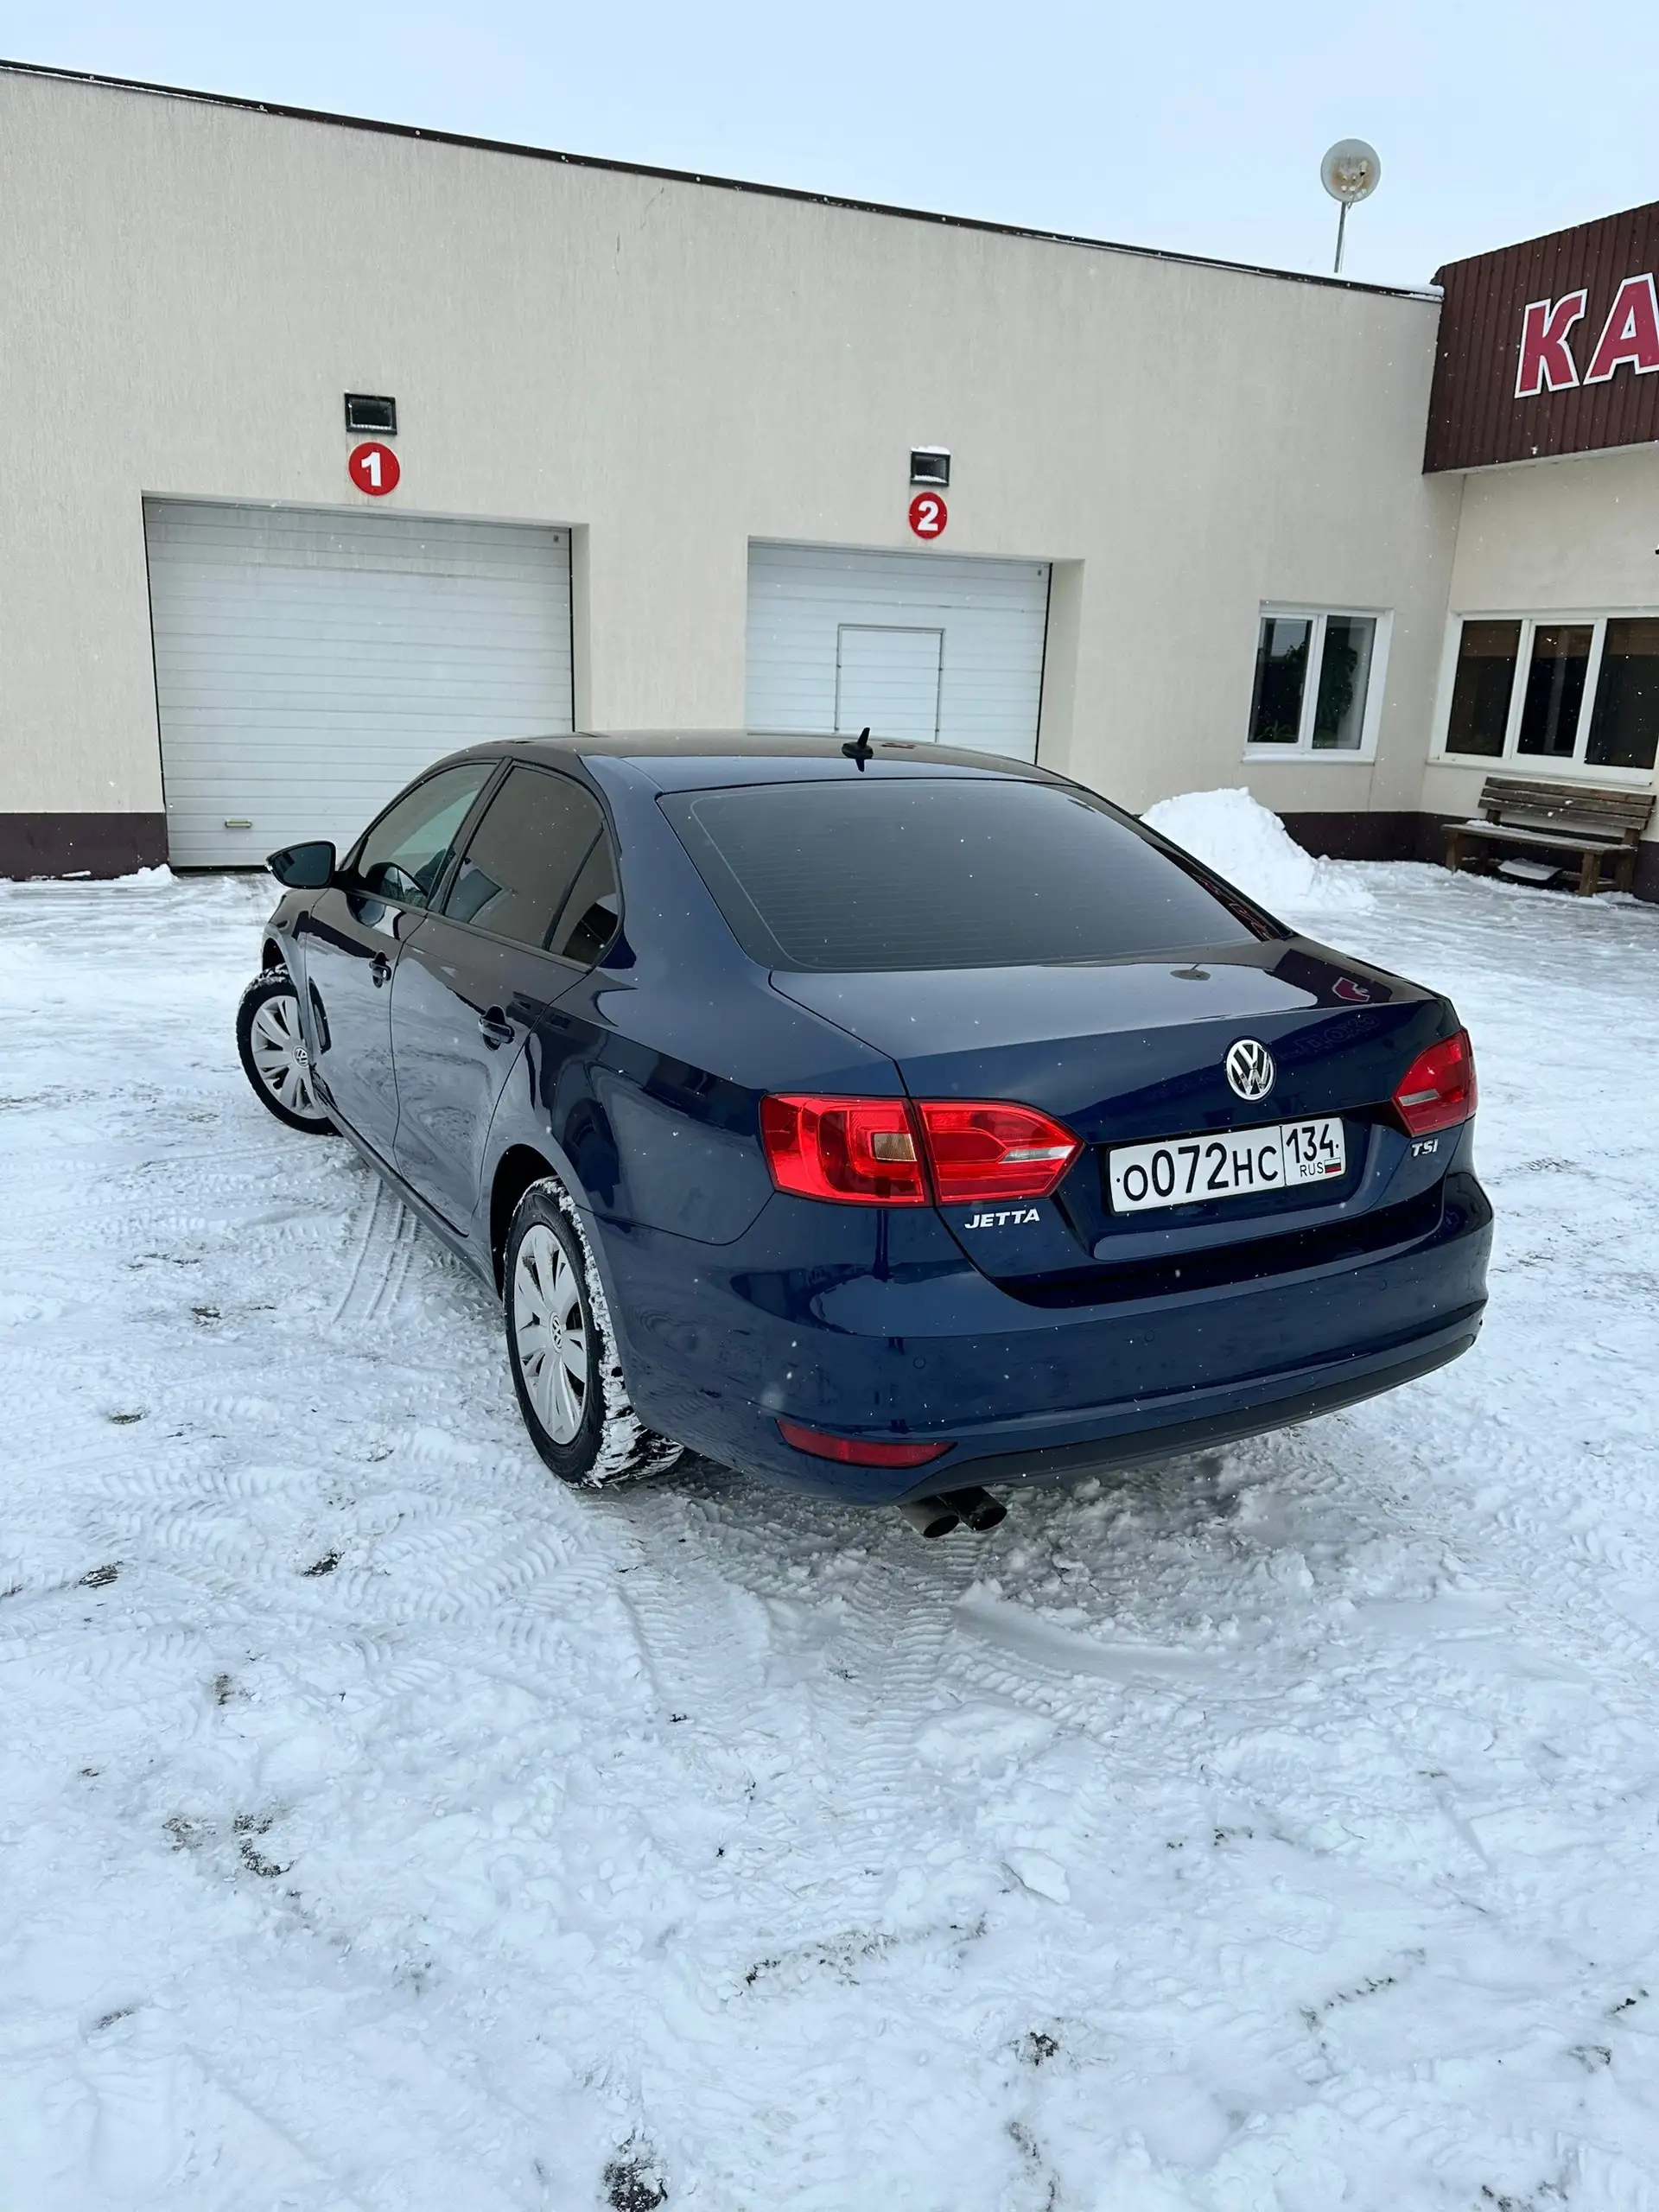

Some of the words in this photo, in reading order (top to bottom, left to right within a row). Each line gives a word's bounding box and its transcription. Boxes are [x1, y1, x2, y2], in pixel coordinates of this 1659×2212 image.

[360, 451, 382, 486] 1
[917, 500, 939, 531] 2
[1410, 1137, 1440, 1158] TSI
[1122, 1141, 1279, 1202] О072НС
[1285, 1123, 1334, 1164] 134
[1299, 1161, 1325, 1178] RUS
[963, 1208, 1041, 1230] JETTA
